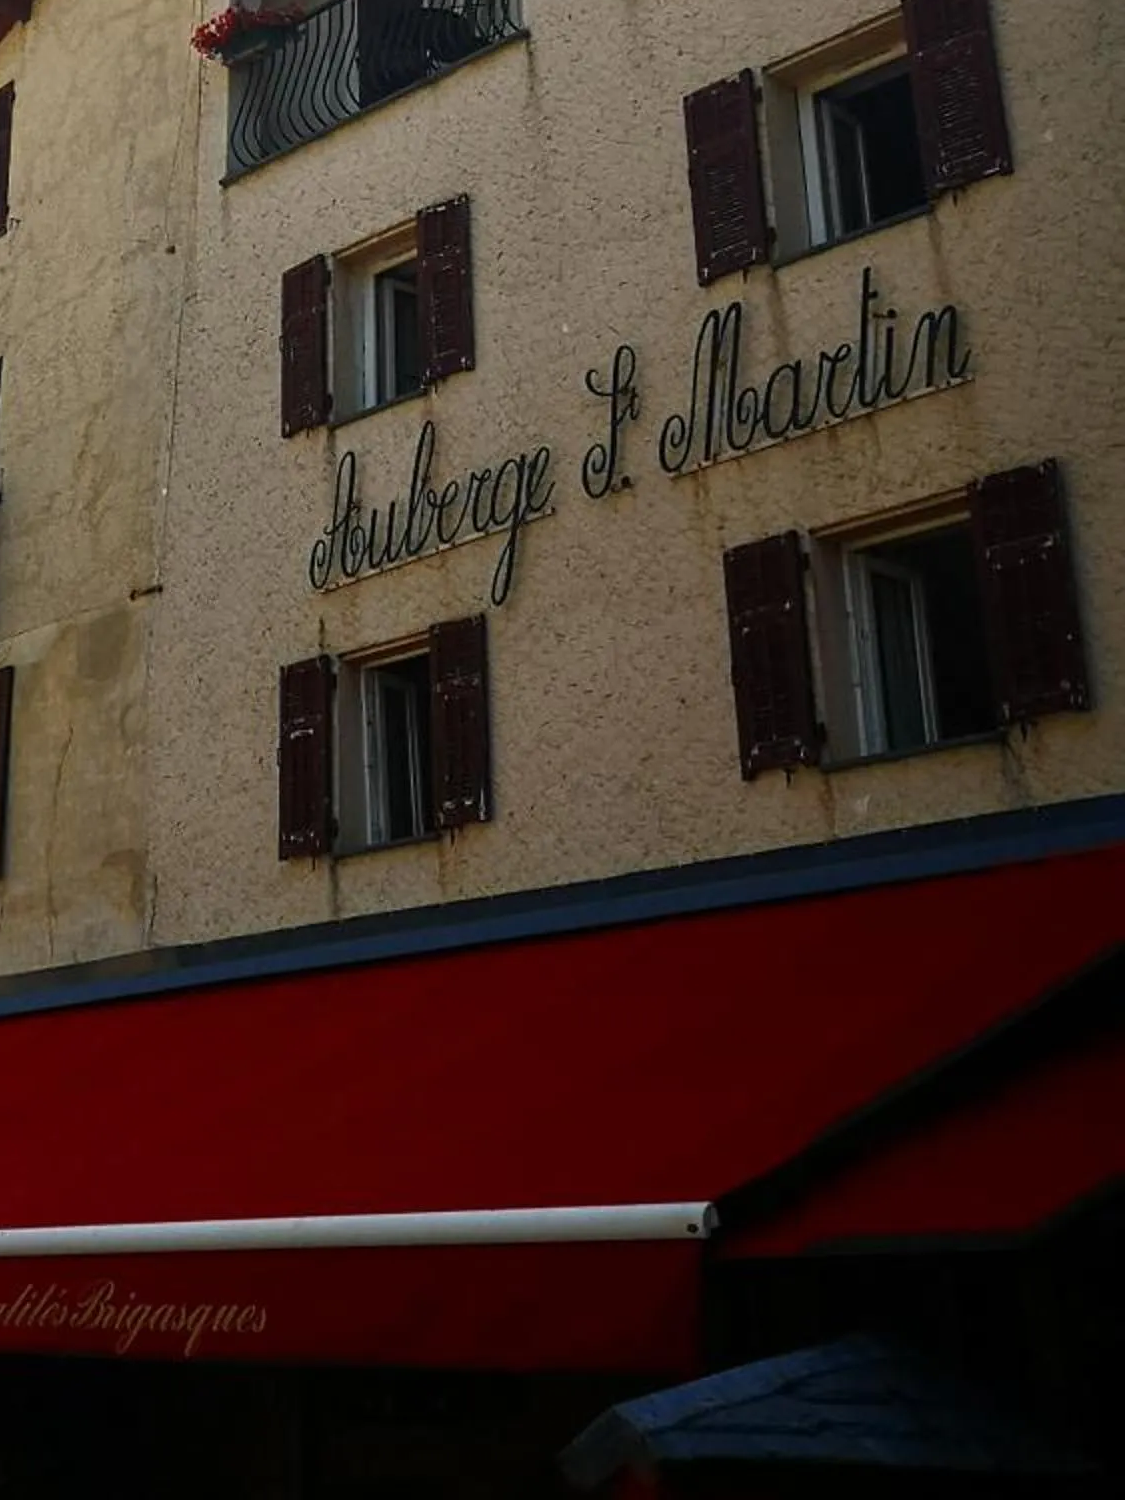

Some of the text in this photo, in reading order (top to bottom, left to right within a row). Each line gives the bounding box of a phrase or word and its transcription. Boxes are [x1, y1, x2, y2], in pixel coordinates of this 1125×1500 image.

[309, 421, 555, 606] Auberge
[659, 266, 972, 474] Martin
[69, 1278, 268, 1357] Brigasques
